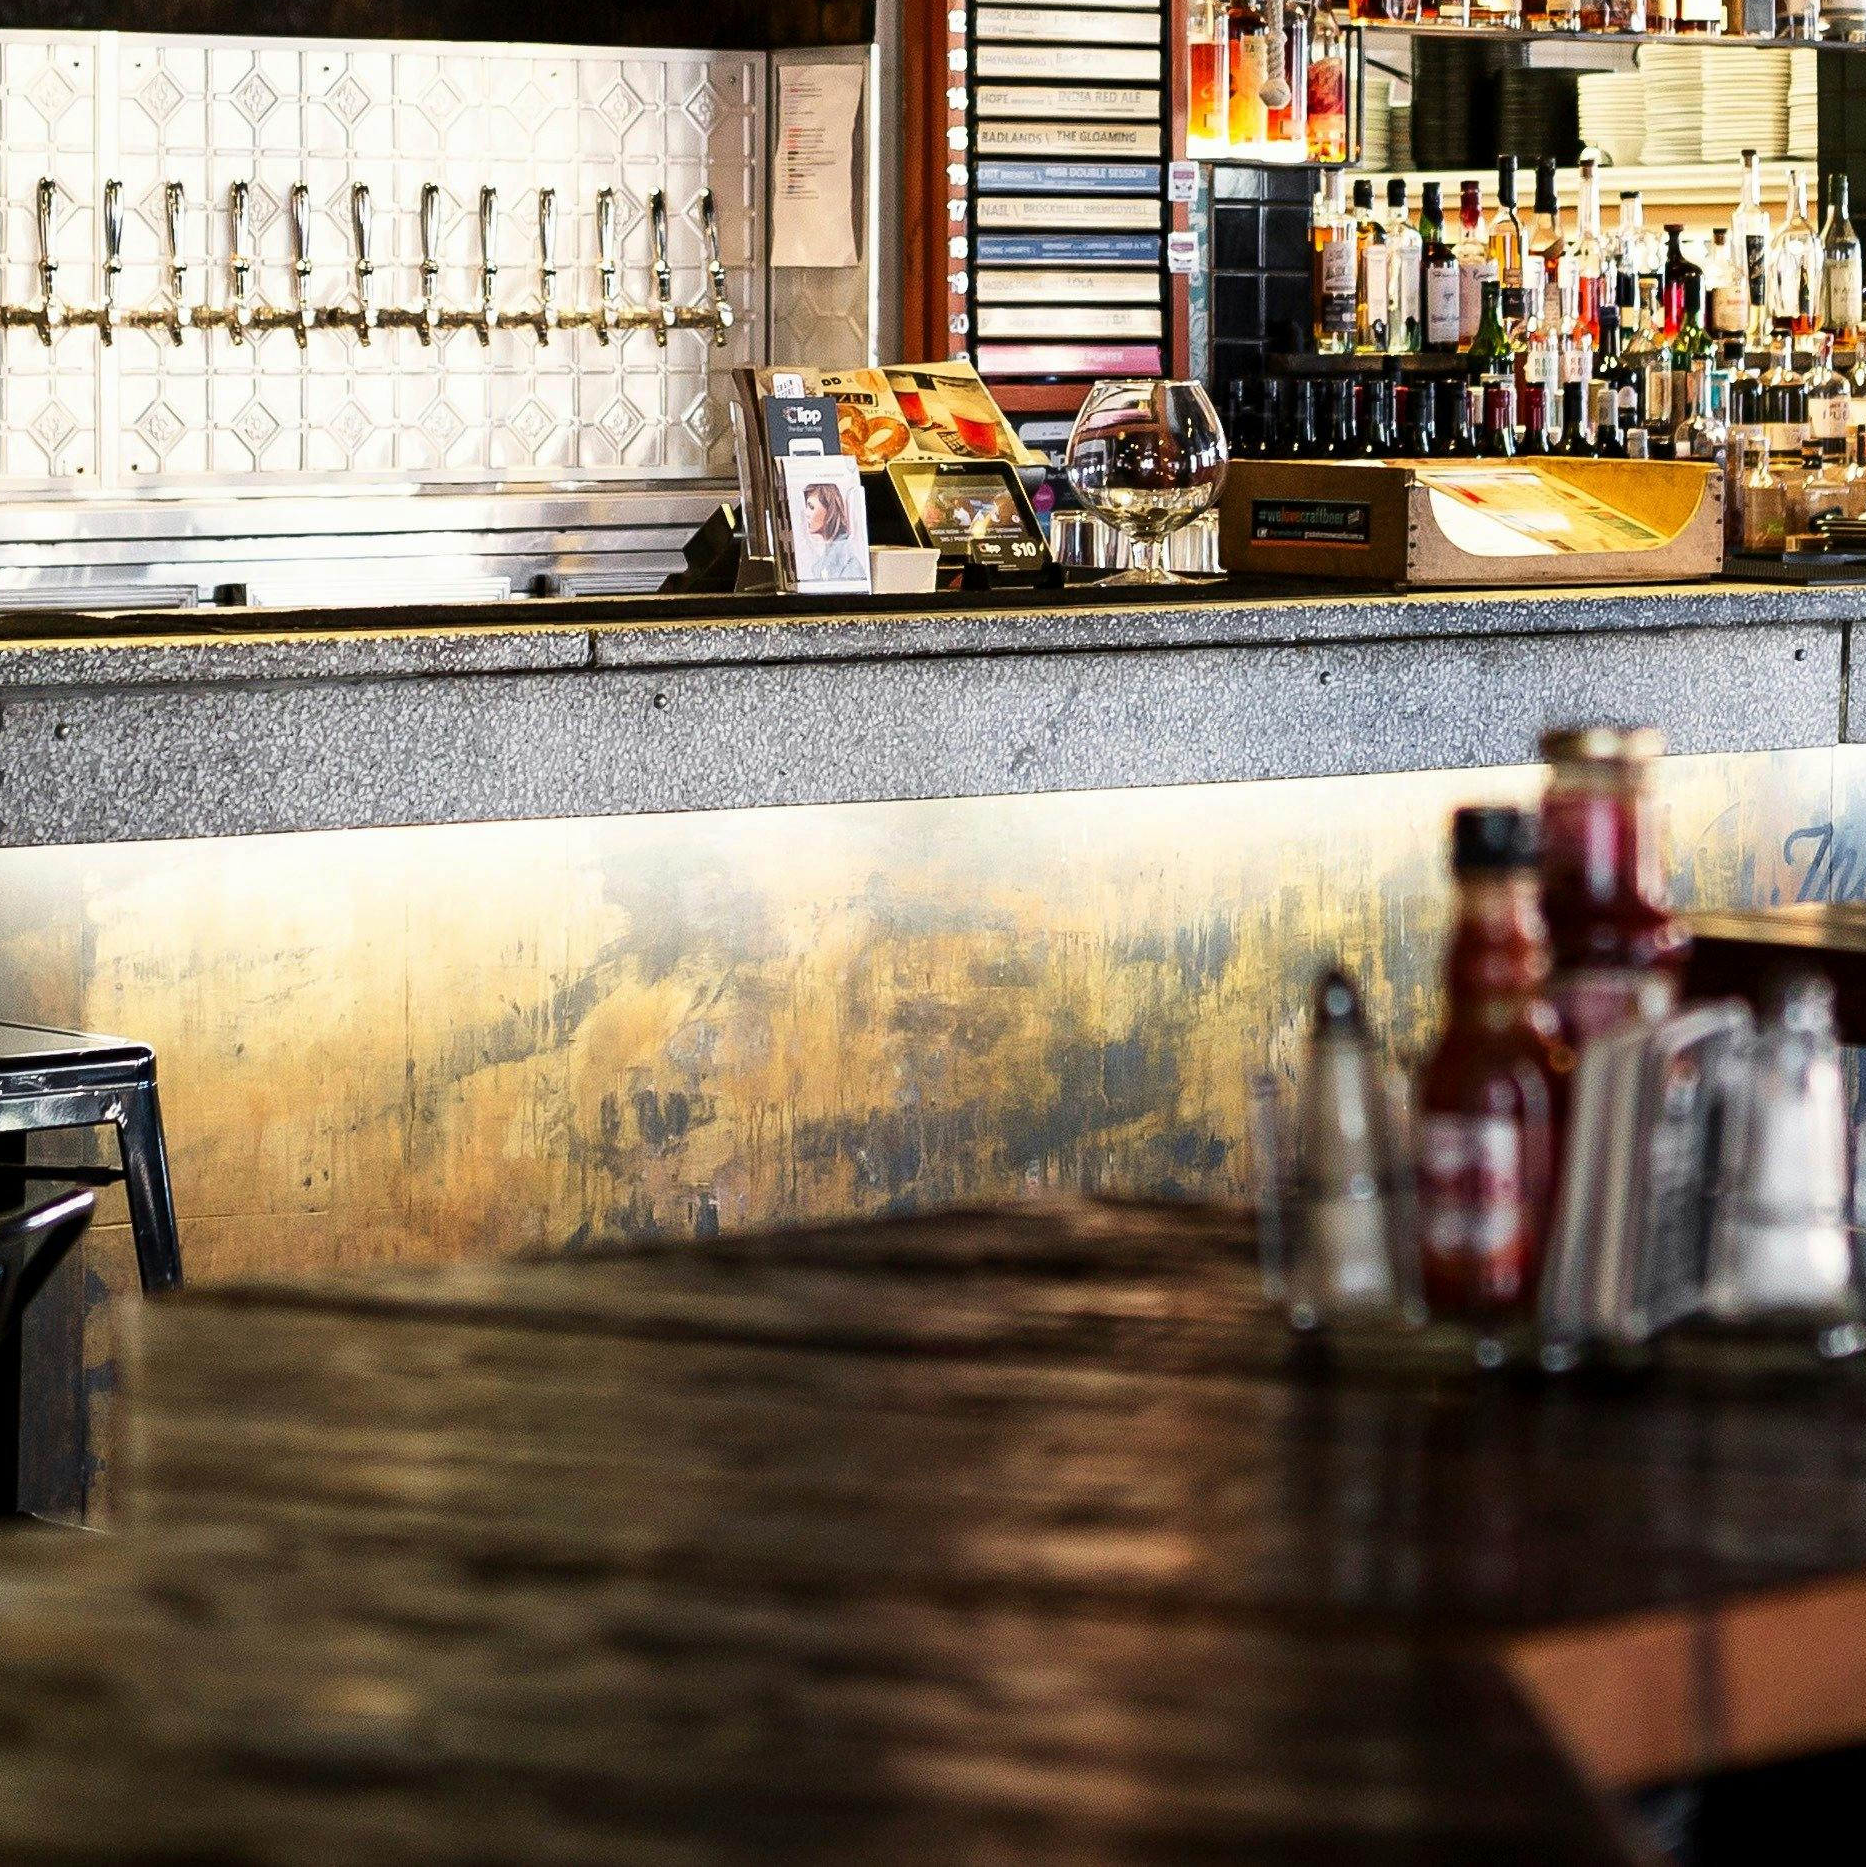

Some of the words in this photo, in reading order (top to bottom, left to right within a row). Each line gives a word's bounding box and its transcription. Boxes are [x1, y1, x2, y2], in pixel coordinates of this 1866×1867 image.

[1095, 91, 1119, 104] RED
[1121, 92, 1142, 105] ALE
[981, 130, 1043, 145] BADLANDS
[1056, 130, 1078, 143] THE
[1079, 130, 1138, 144] GLOAMING
[1070, 167, 1107, 179] DOUBLE
[982, 204, 1009, 218] NAIL
[948, 313, 970, 334] 20
[784, 405, 823, 425] Clipp
